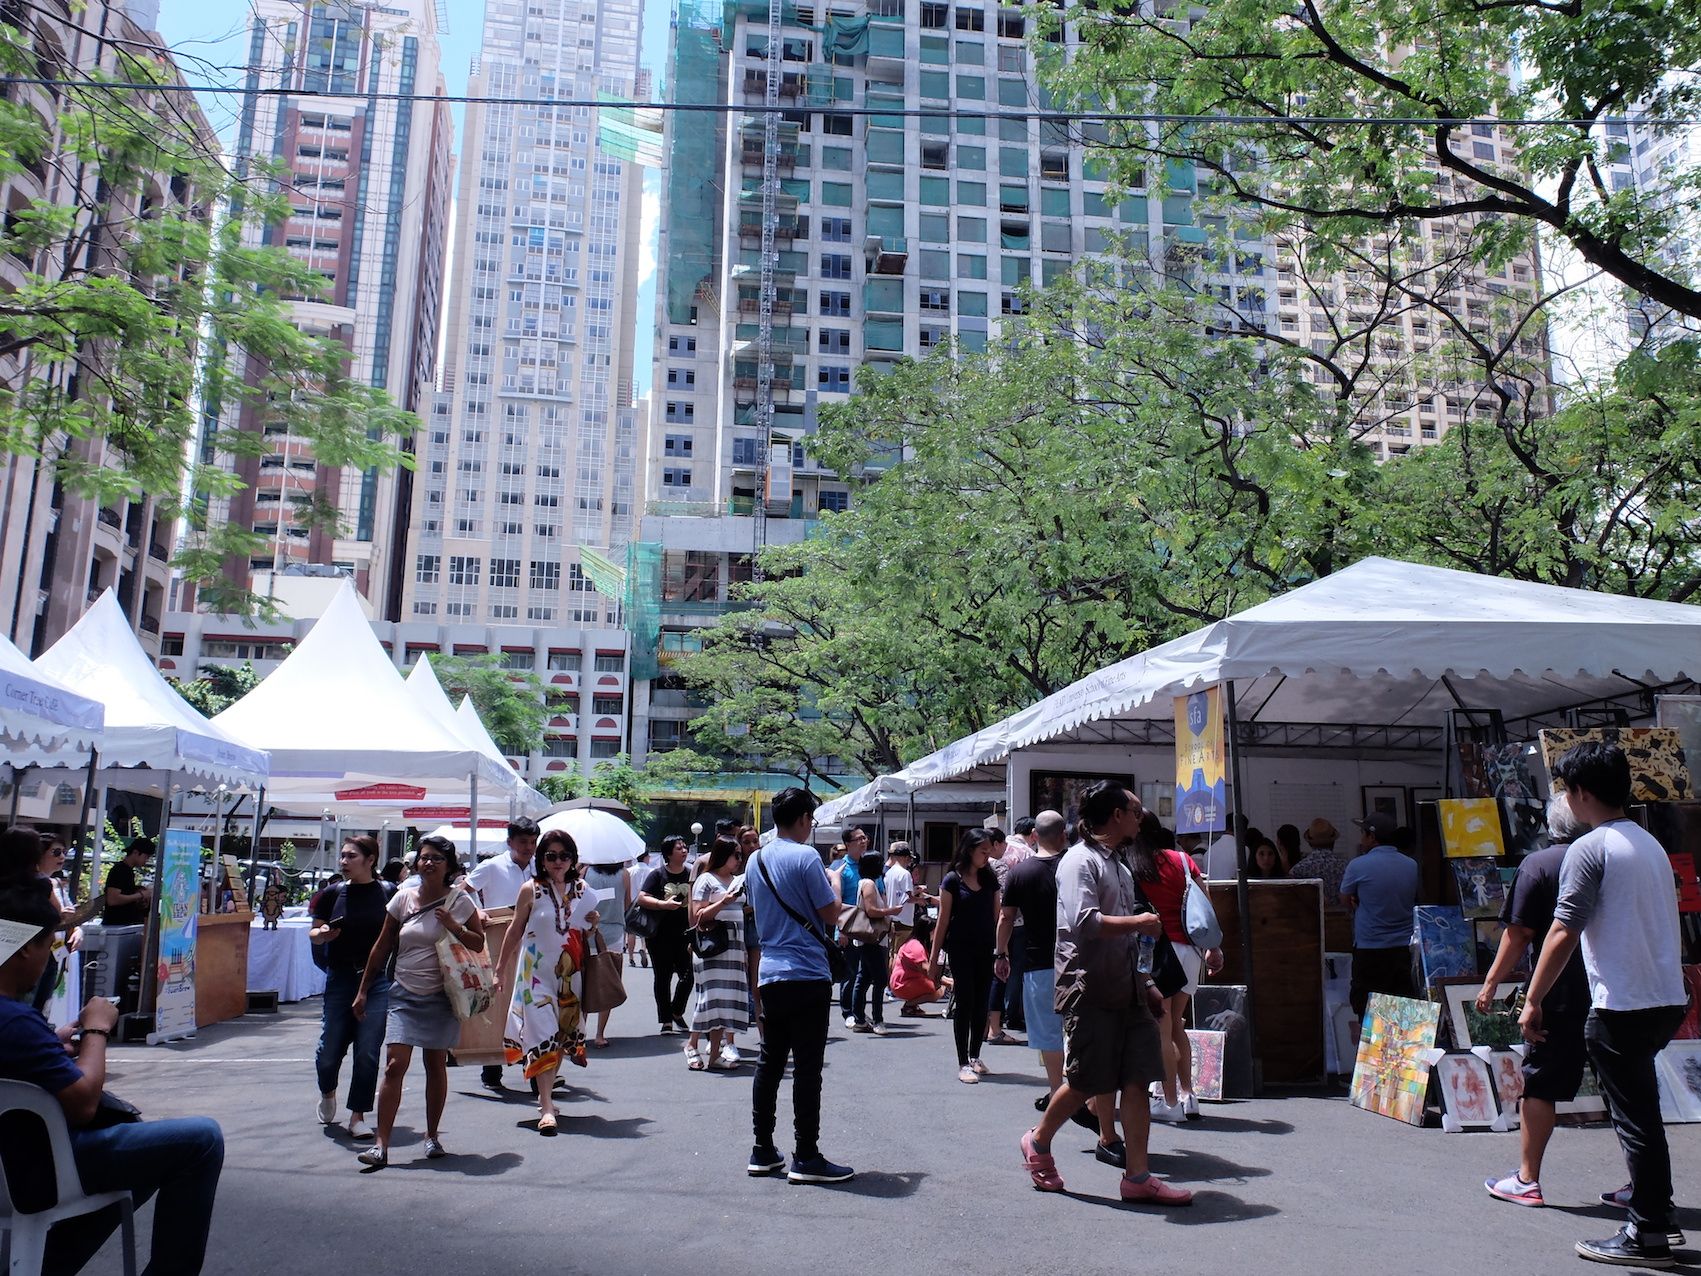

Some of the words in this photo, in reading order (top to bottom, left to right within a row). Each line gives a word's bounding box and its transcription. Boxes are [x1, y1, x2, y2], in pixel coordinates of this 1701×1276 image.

[6, 683, 29, 702] Corner
[1189, 705, 1202, 725] sfa
[1180, 753, 1196, 767] FINE
